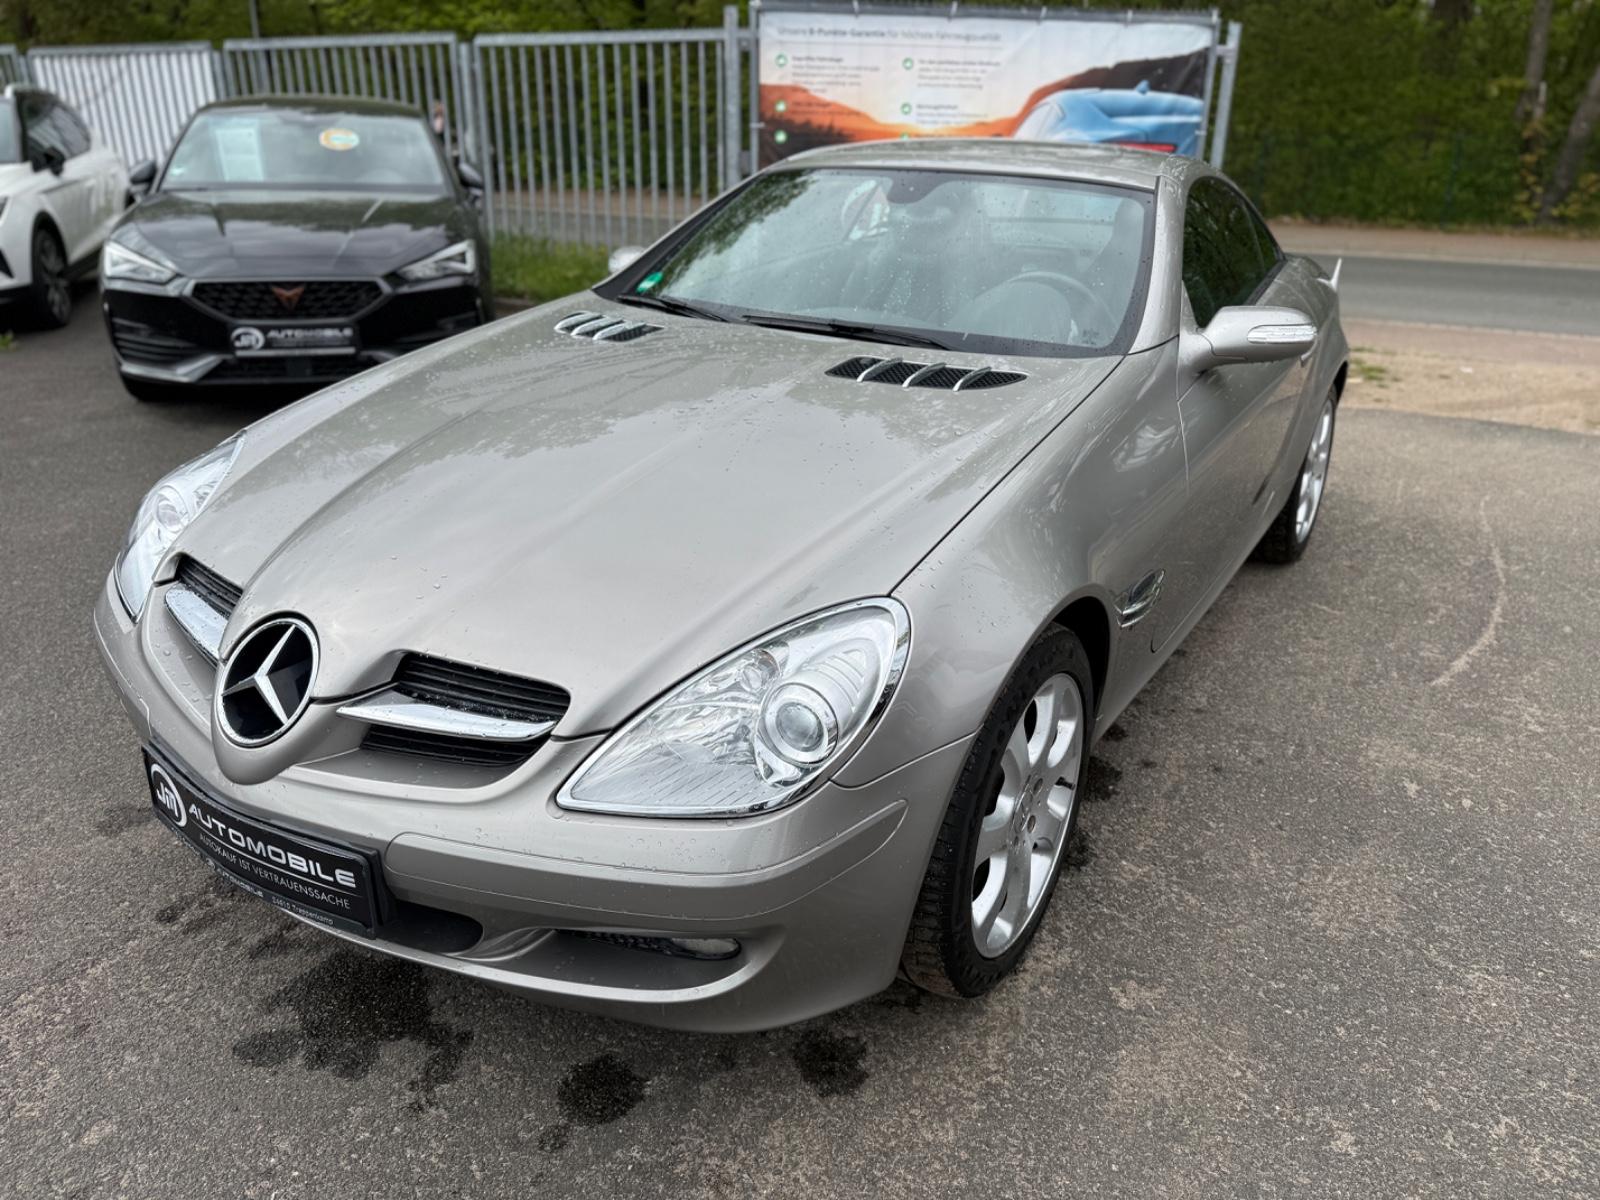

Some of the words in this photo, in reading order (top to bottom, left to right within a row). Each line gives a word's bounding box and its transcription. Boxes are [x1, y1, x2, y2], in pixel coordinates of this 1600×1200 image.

[267, 327, 354, 339] AUTOMOBILE
[188, 803, 357, 888] AUTOMOBILE
[200, 832, 237, 864] AUTOKAUF
[240, 858, 251, 872] IST
[252, 864, 351, 910] VERTRAUENSSACHE
